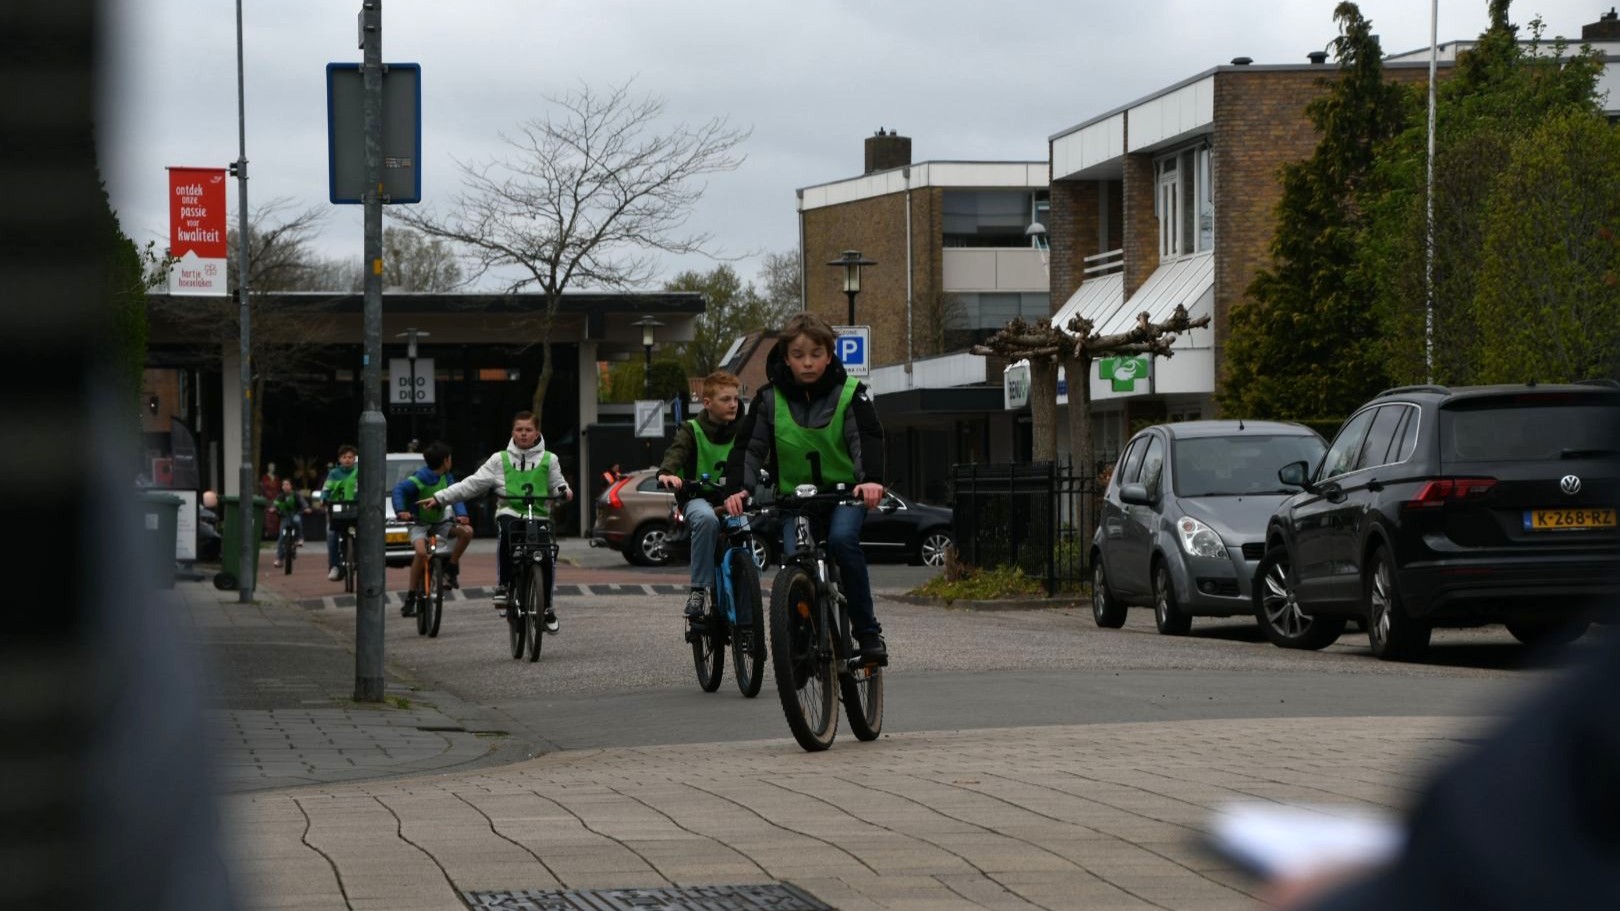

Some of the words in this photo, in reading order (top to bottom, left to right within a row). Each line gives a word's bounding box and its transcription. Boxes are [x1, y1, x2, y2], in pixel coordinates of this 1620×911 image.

[176, 184, 203, 196] ontdek
[182, 196, 198, 205] onze
[181, 204, 207, 219] passie
[178, 227, 219, 242] kwaliteit
[842, 340, 858, 362] P
[1537, 510, 1612, 527] K-268-RZ
